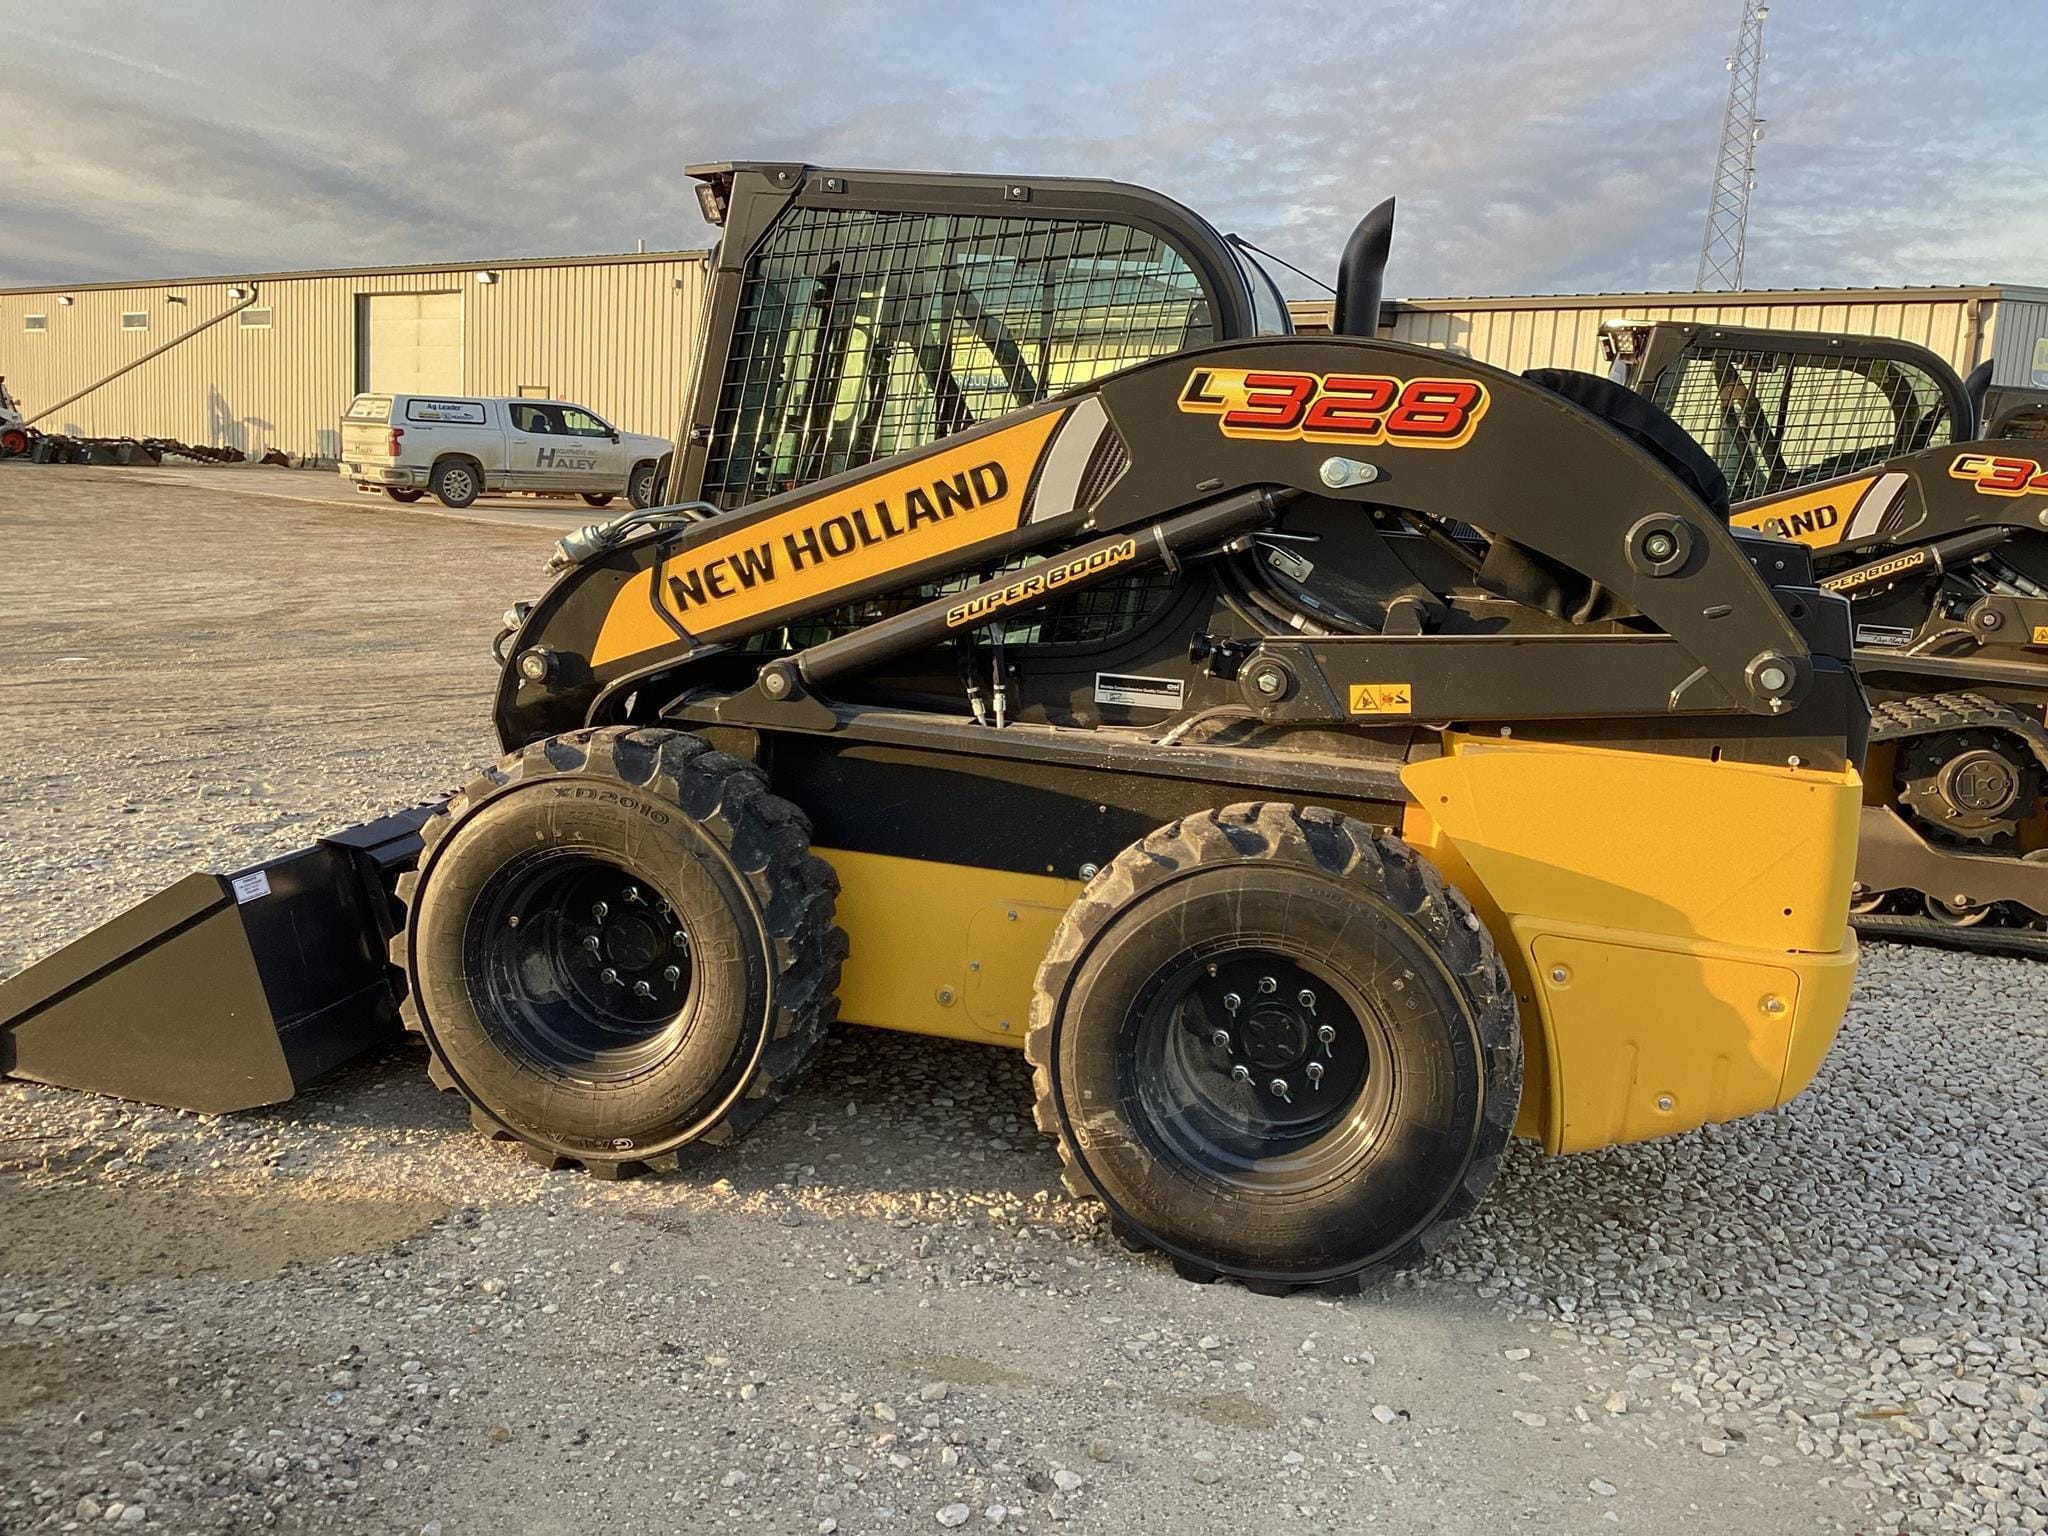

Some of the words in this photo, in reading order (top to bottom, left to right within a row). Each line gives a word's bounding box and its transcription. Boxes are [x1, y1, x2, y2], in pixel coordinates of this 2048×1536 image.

[1178, 367, 1490, 449] L328
[536, 447, 597, 470] HALEY
[667, 541, 776, 613] NEW
[783, 459, 1010, 571] HOLLAND
[1752, 504, 1838, 540] AND
[946, 574, 1044, 628] SUPER
[1046, 538, 1136, 591] BOOM
[1866, 551, 1925, 580] BOOM
[553, 786, 670, 826] XD2010
